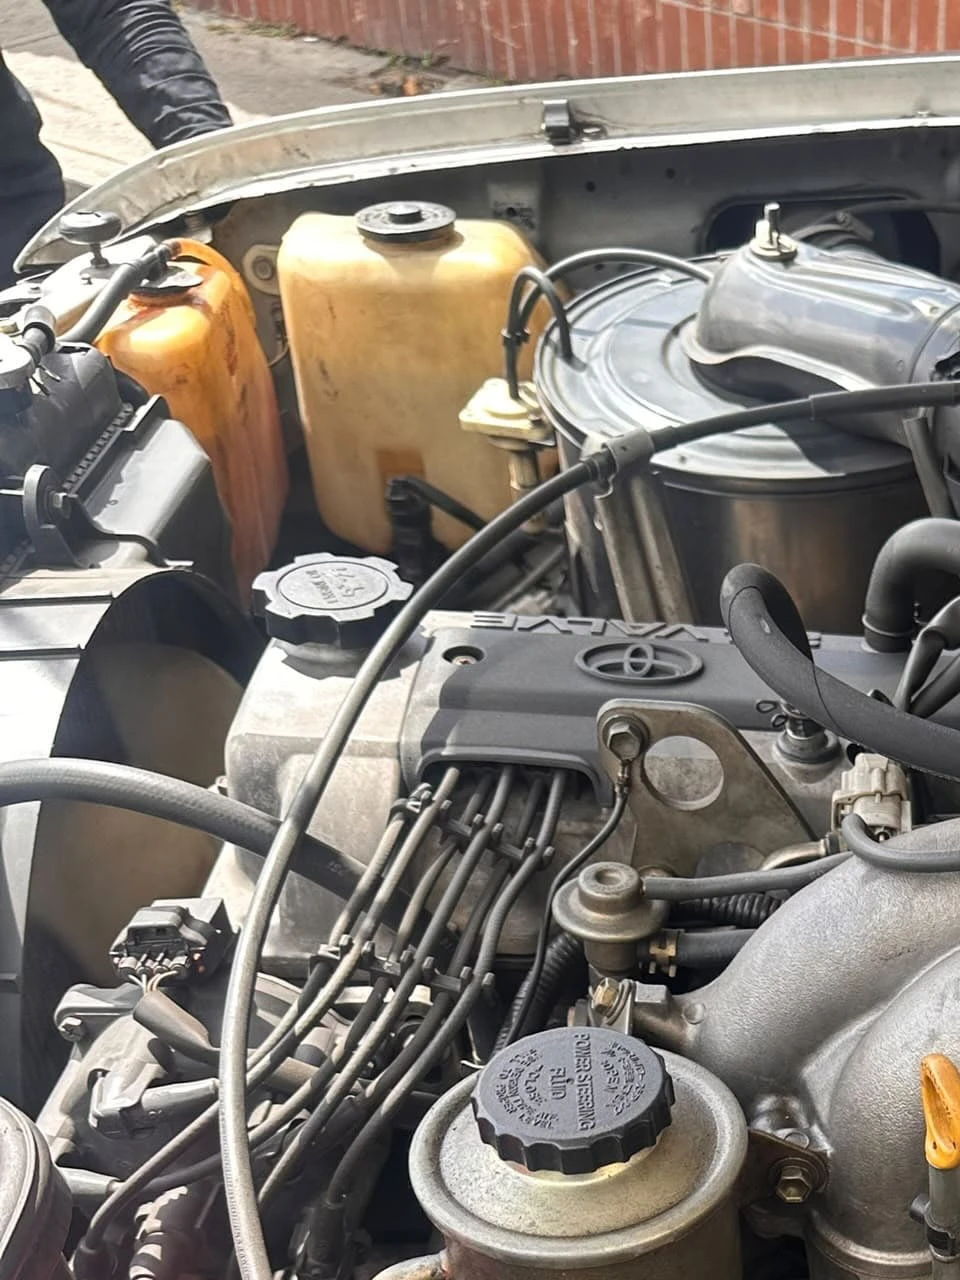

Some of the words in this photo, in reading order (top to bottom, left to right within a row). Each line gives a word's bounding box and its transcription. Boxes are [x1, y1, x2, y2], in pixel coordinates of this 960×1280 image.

[471, 609, 710, 643] VALVE
[573, 1033, 592, 1074] POWER
[549, 1065, 568, 1101] FLUID
[575, 1074, 597, 1132] STEERING
